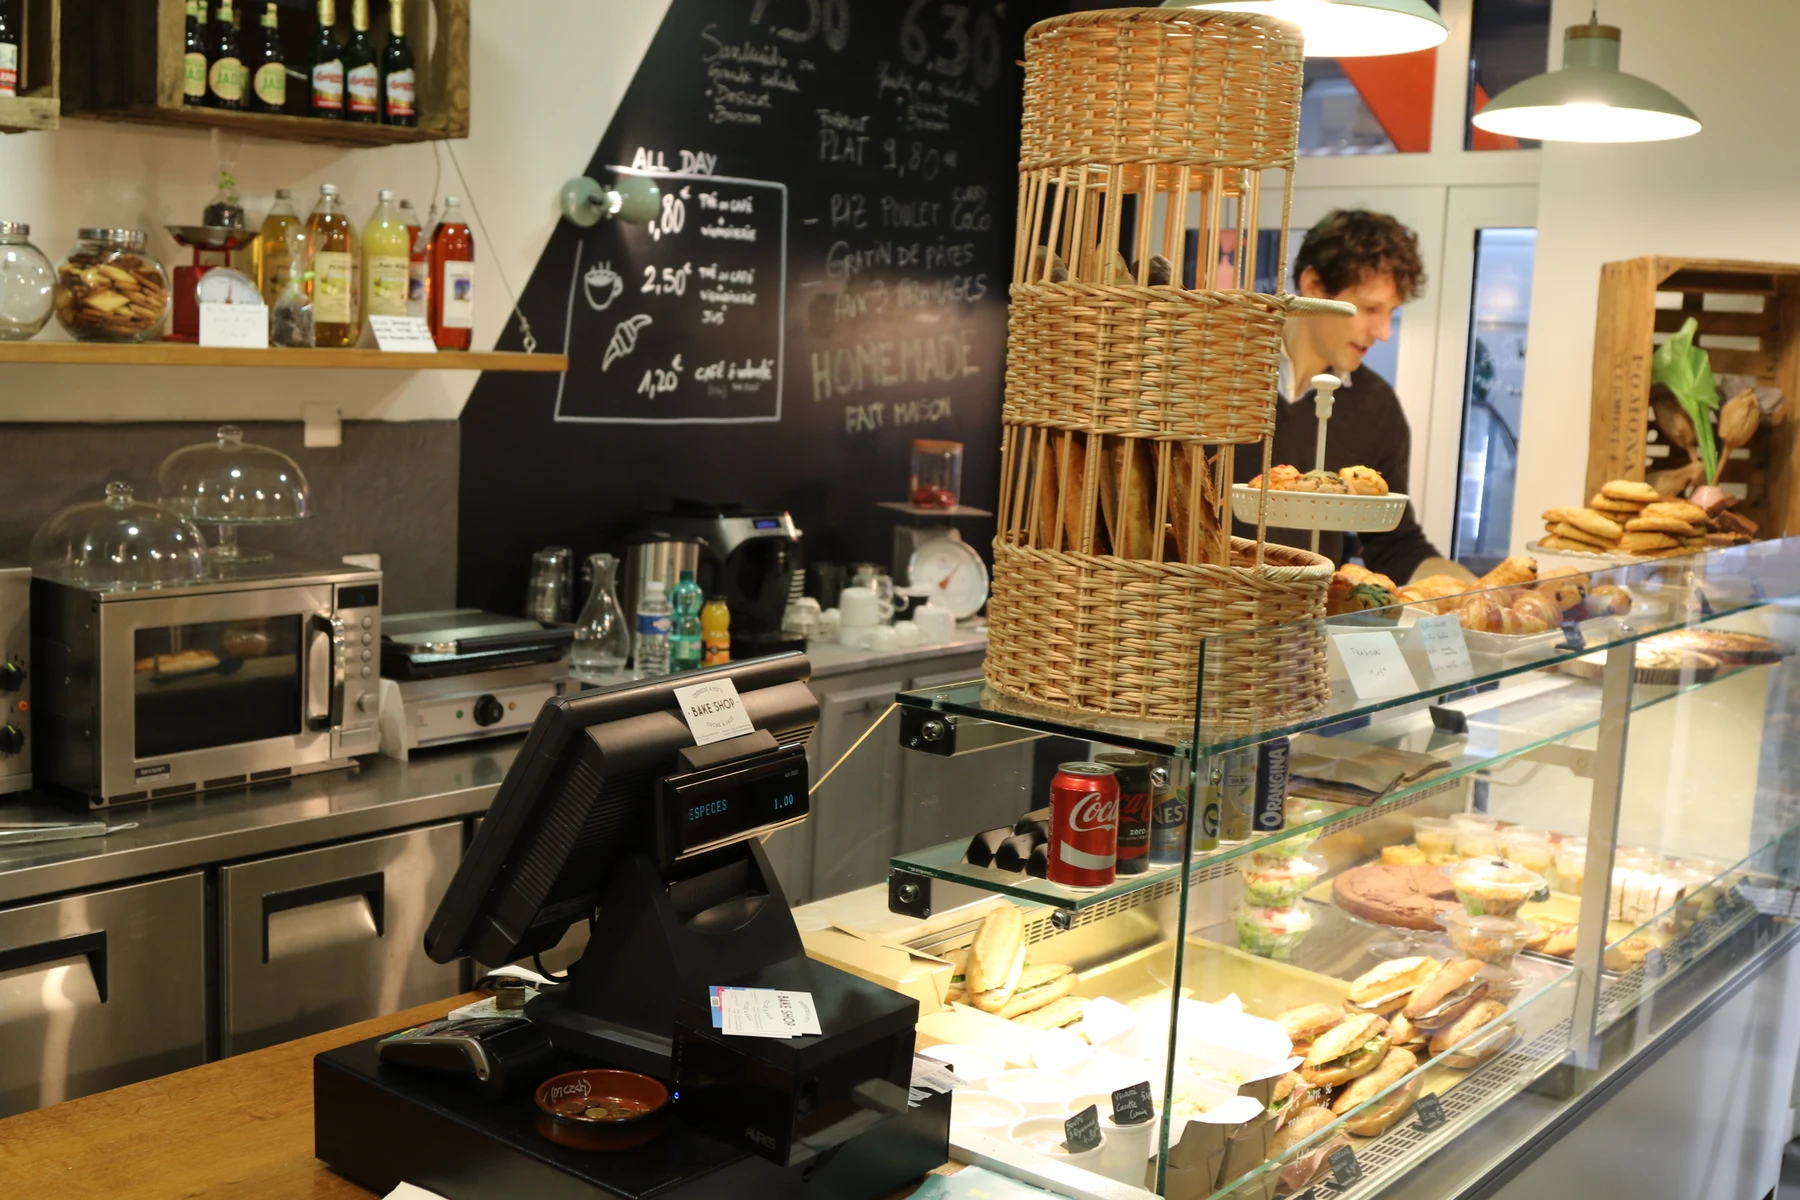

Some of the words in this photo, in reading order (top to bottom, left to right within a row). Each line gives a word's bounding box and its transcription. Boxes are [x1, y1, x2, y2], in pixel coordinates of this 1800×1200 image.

[630, 146, 670, 172] ALL
[676, 150, 718, 175] DAY
[818, 128, 871, 167] PLAT
[830, 193, 868, 229] RIZ
[880, 195, 941, 229] POULET
[897, 242, 920, 268] DE
[845, 401, 886, 434] FAIT
[893, 396, 952, 426] MAISON
[691, 703, 713, 717] BAKE
[713, 698, 735, 712] SHOP
[1260, 747, 1288, 827] ORANGINA
[689, 799, 728, 820] ESPECES
[774, 794, 794, 810] 1.00
[1129, 828, 1146, 836] zero
[777, 995, 792, 1009] BAKE
[781, 1009, 796, 1027] SHOP
